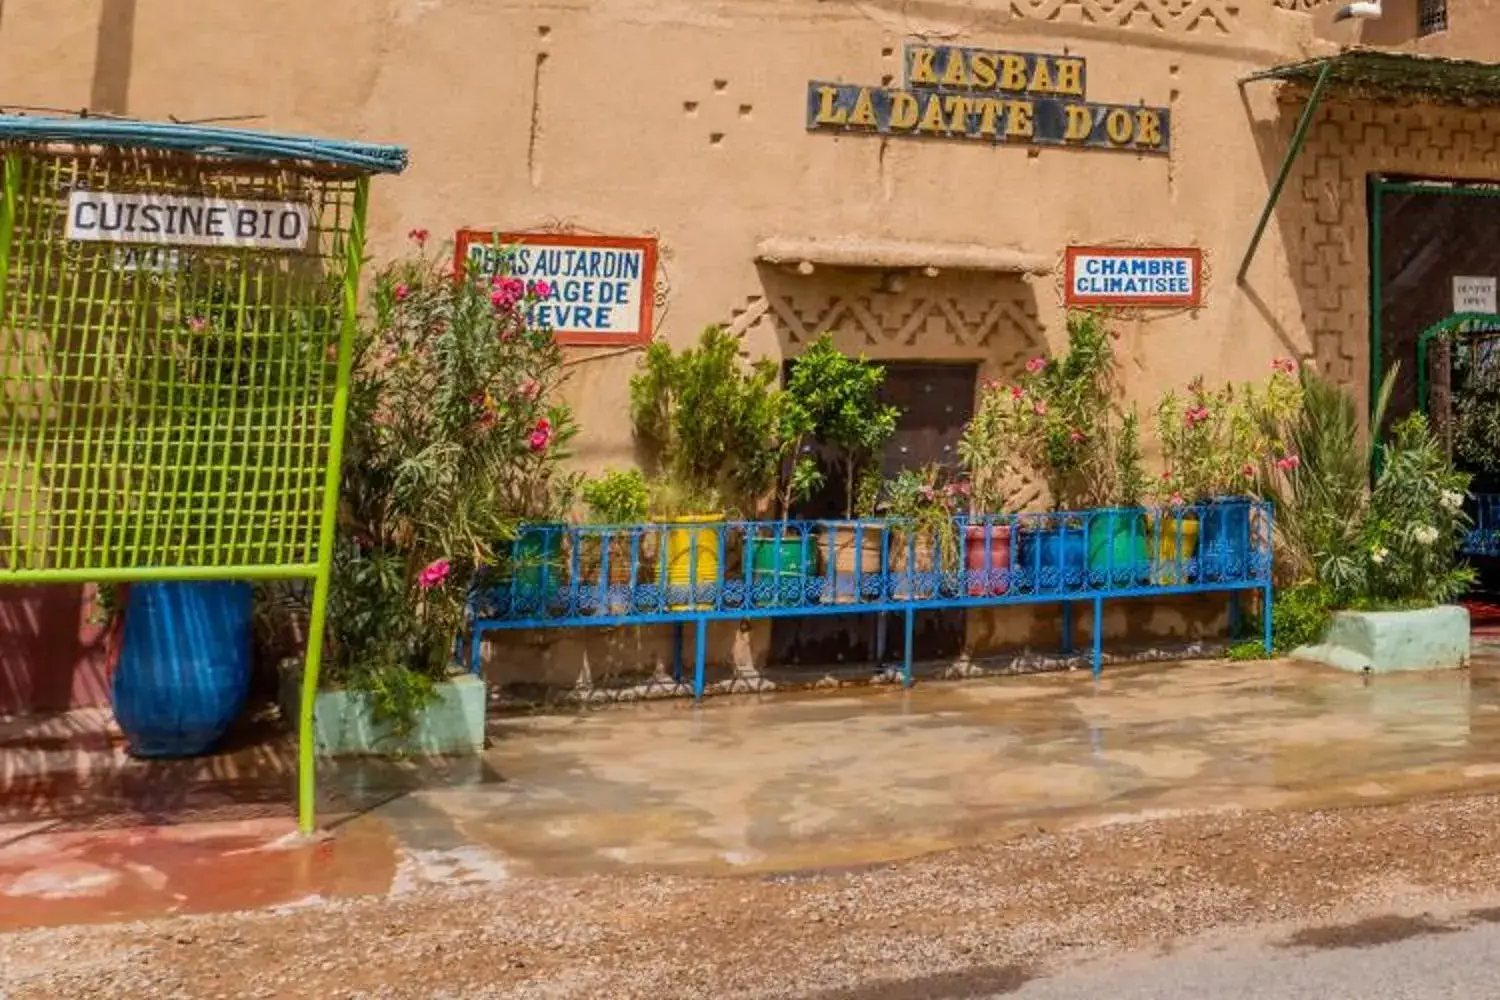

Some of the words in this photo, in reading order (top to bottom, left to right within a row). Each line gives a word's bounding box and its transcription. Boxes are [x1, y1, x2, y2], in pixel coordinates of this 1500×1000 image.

[910, 47, 1084, 96] KASBAH
[816, 86, 879, 126] LA
[887, 93, 1034, 139] DATTE
[1064, 103, 1161, 147] D'OR
[74, 201, 227, 237] CUISINE
[236, 208, 301, 240] BIO
[1086, 259, 1187, 276] CHAMBRE
[1077, 277, 1190, 293] CLIMATISEE
[526, 304, 613, 328] EVRE
